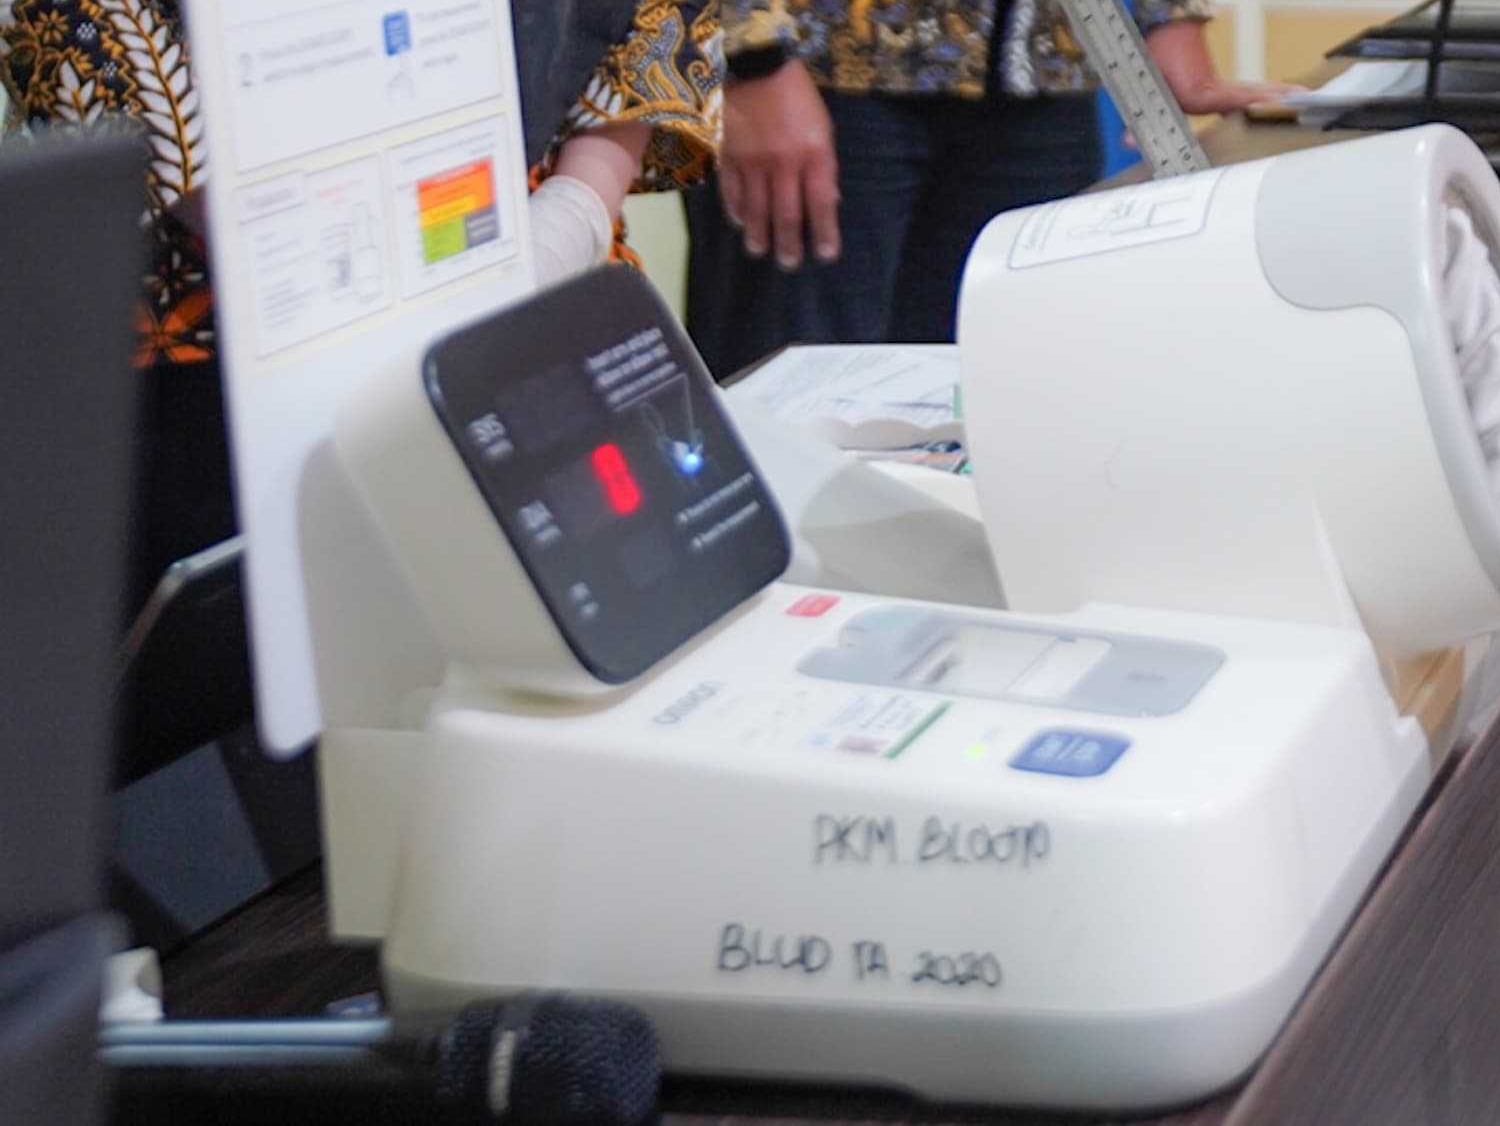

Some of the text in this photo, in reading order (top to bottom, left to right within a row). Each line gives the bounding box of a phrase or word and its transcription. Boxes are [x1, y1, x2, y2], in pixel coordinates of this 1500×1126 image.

[813, 813, 898, 865] PKM
[717, 922, 1002, 987] BLUD TA 2020
